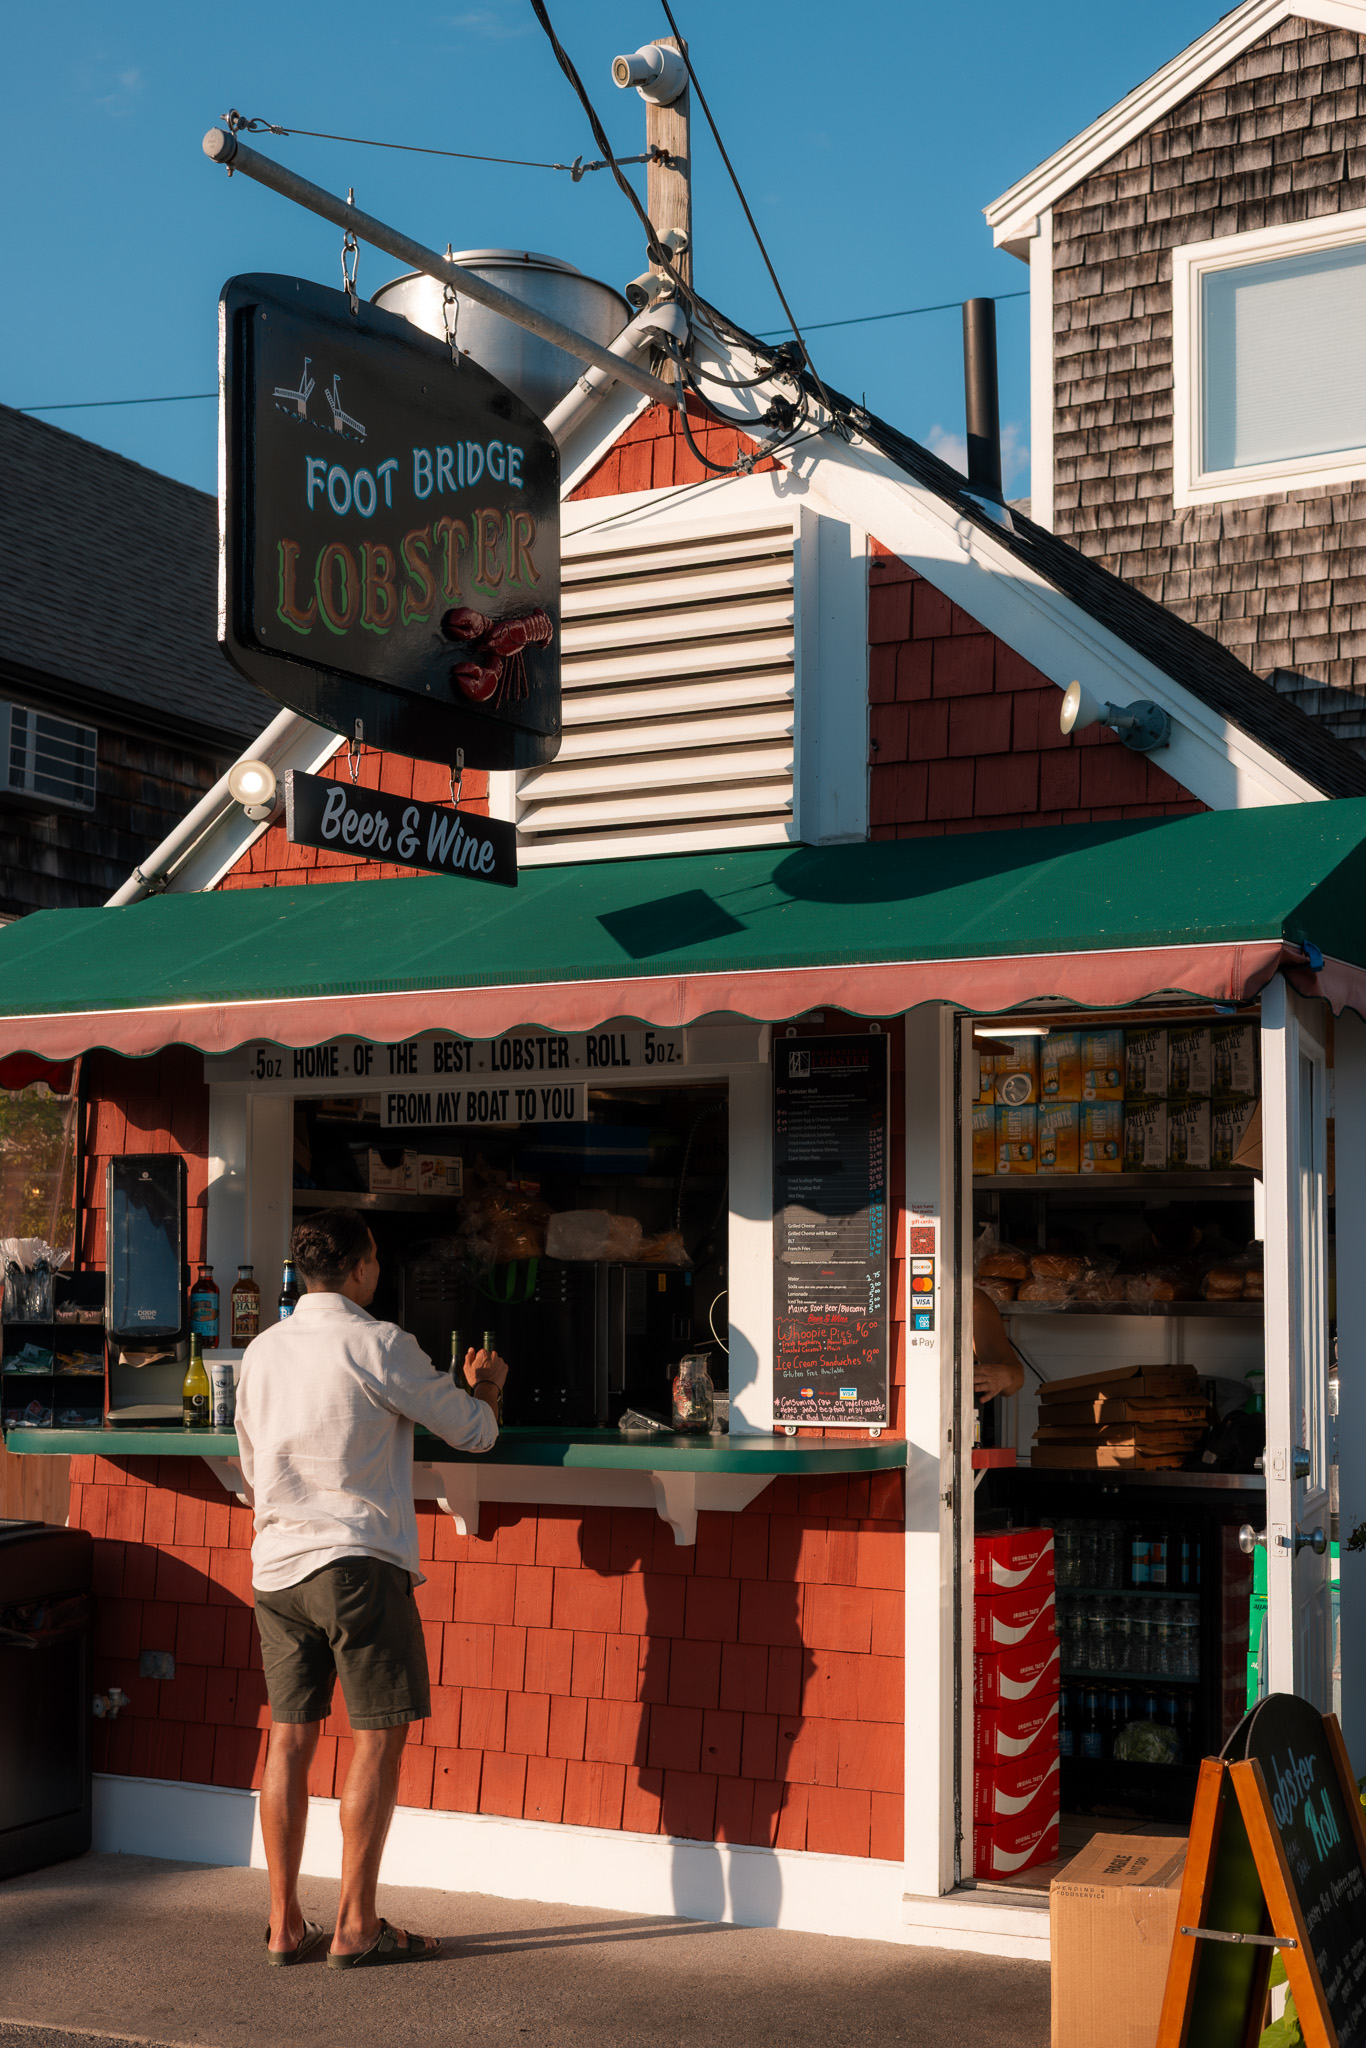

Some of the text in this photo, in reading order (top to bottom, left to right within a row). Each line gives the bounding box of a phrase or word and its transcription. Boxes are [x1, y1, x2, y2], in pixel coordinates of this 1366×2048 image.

[305, 439, 524, 518] FOOT BRIDGE
[275, 507, 541, 636] LOBSTER
[320, 786, 496, 874] Beer & Wine
[294, 1046, 338, 1077] HOME
[354, 1044, 373, 1075] OF
[387, 1043, 417, 1074] THE
[434, 1040, 474, 1074] BEST
[491, 1036, 569, 1072] LOBSTER
[586, 1034, 630, 1068] ROLL
[388, 1088, 575, 1124] FROM MY BOAT TO YOU
[236, 1295, 248, 1303] JOE
[807, 1314, 823, 1323] Beer
[777, 1324, 852, 1341] Whoopie Pies
[919, 1338, 935, 1348] Pay
[775, 1354, 862, 1370] Ice Cream Sandwiches
[783, 1369, 804, 1378] Gluten
[1012, 1552, 1039, 1562] ORIGINAL TASTE
[1013, 1610, 1029, 1619] ORIGINAL
[1020, 1661, 1045, 1674] ORIGINAL TASTE
[1018, 1718, 1044, 1732] ORIGINAL TASTE
[1016, 1774, 1043, 1789] ORIGINAL TASTE
[1304, 1786, 1341, 1863] Roll
[1015, 1830, 1042, 1845] ORIGINAL TASTE
[1056, 1890, 1105, 1900] FOODSERVICE
